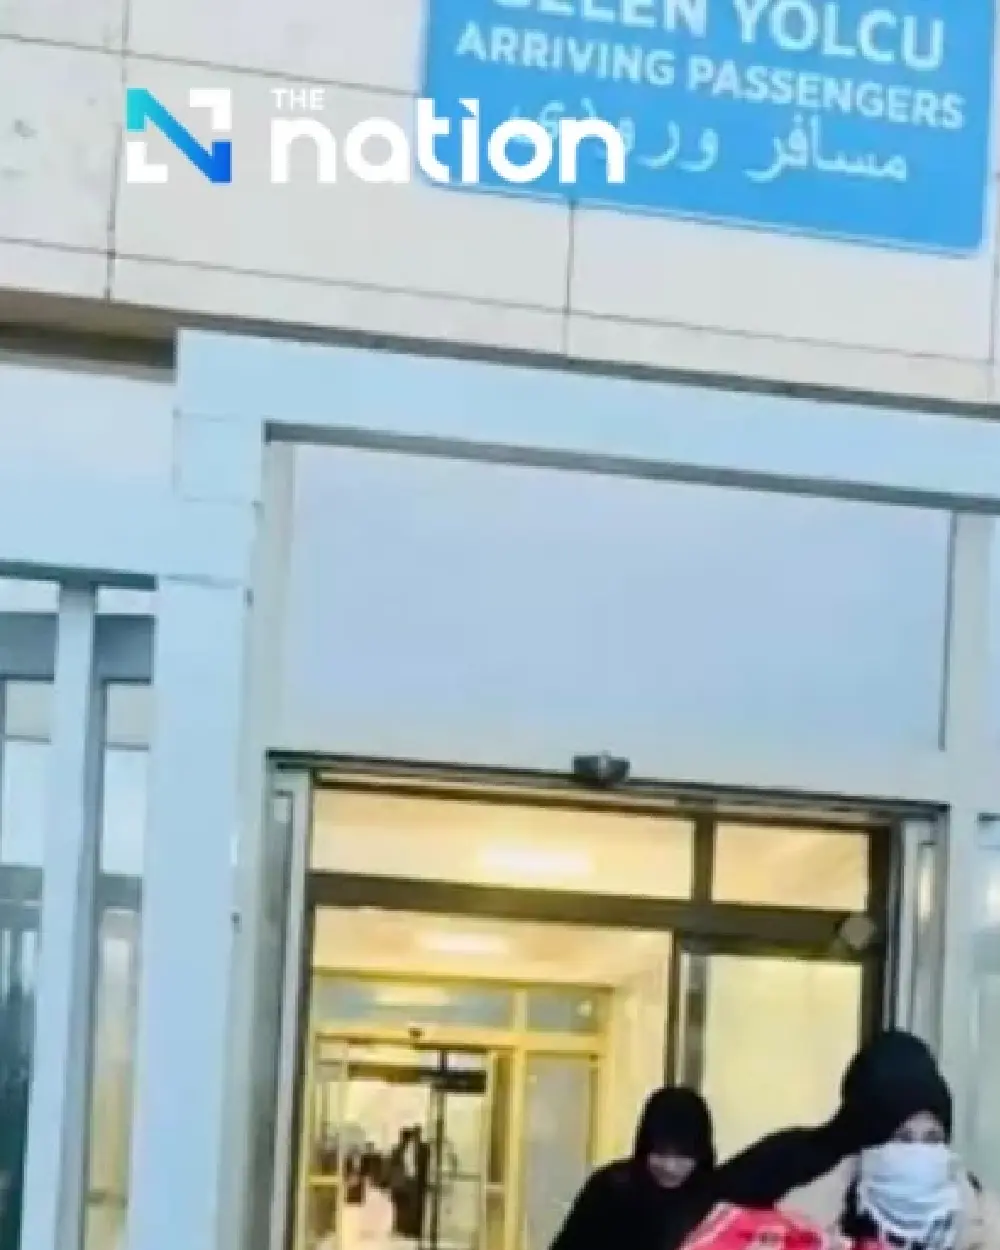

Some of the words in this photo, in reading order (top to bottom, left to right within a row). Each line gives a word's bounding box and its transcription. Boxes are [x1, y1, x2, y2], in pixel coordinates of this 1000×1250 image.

[493, 0, 708, 38] LEN
[732, 0, 945, 71] YOLCU
[455, 20, 676, 86] ARRIVING
[686, 56, 966, 129] PASSENGERS
[743, 113, 907, 183] مسافر
